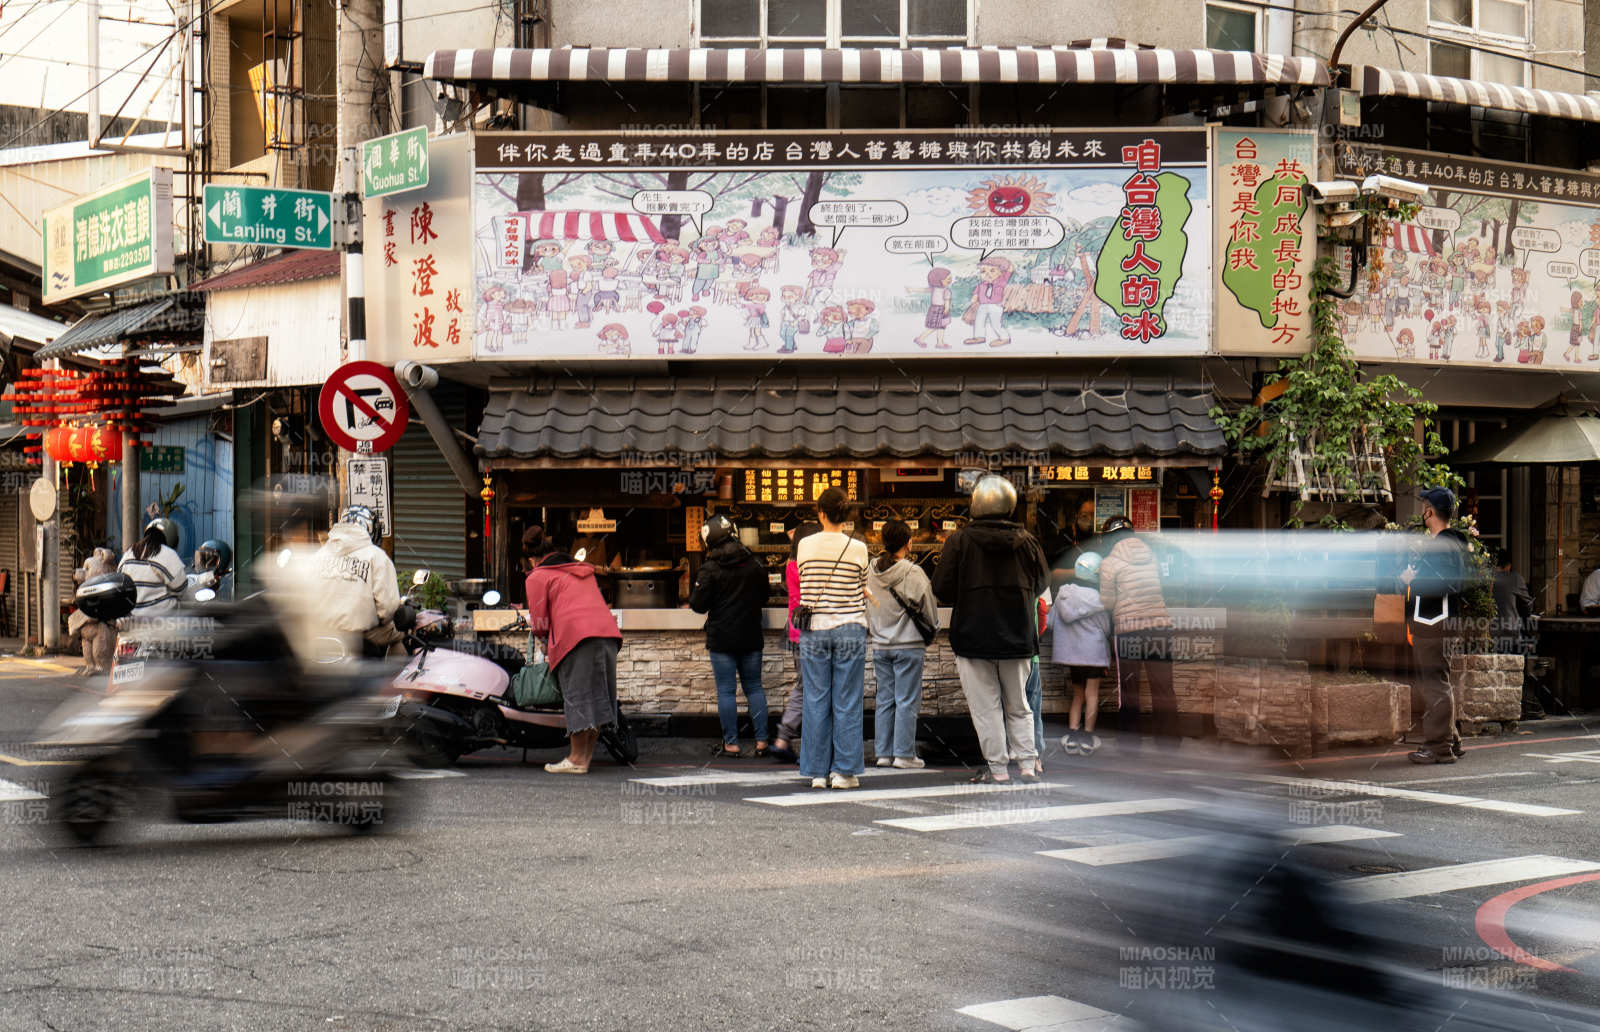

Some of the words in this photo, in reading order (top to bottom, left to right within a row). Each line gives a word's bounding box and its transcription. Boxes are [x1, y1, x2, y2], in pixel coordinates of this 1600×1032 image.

[371, 136, 419, 168] 國華街
[373, 172, 404, 190] Guohua
[408, 170, 421, 183] St.
[223, 190, 316, 222] 蘭井街
[1230, 136, 1262, 271] 台灣是你我
[222, 222, 286, 244] Lanjing
[295, 226, 316, 243] St.
[383, 208, 398, 268] 畫家
[1121, 138, 1162, 344] 咱台灣人的冰
[1272, 157, 1305, 345] 共同成長的地方
[411, 201, 439, 348] 陳澄波
[446, 288, 463, 345] 故居
